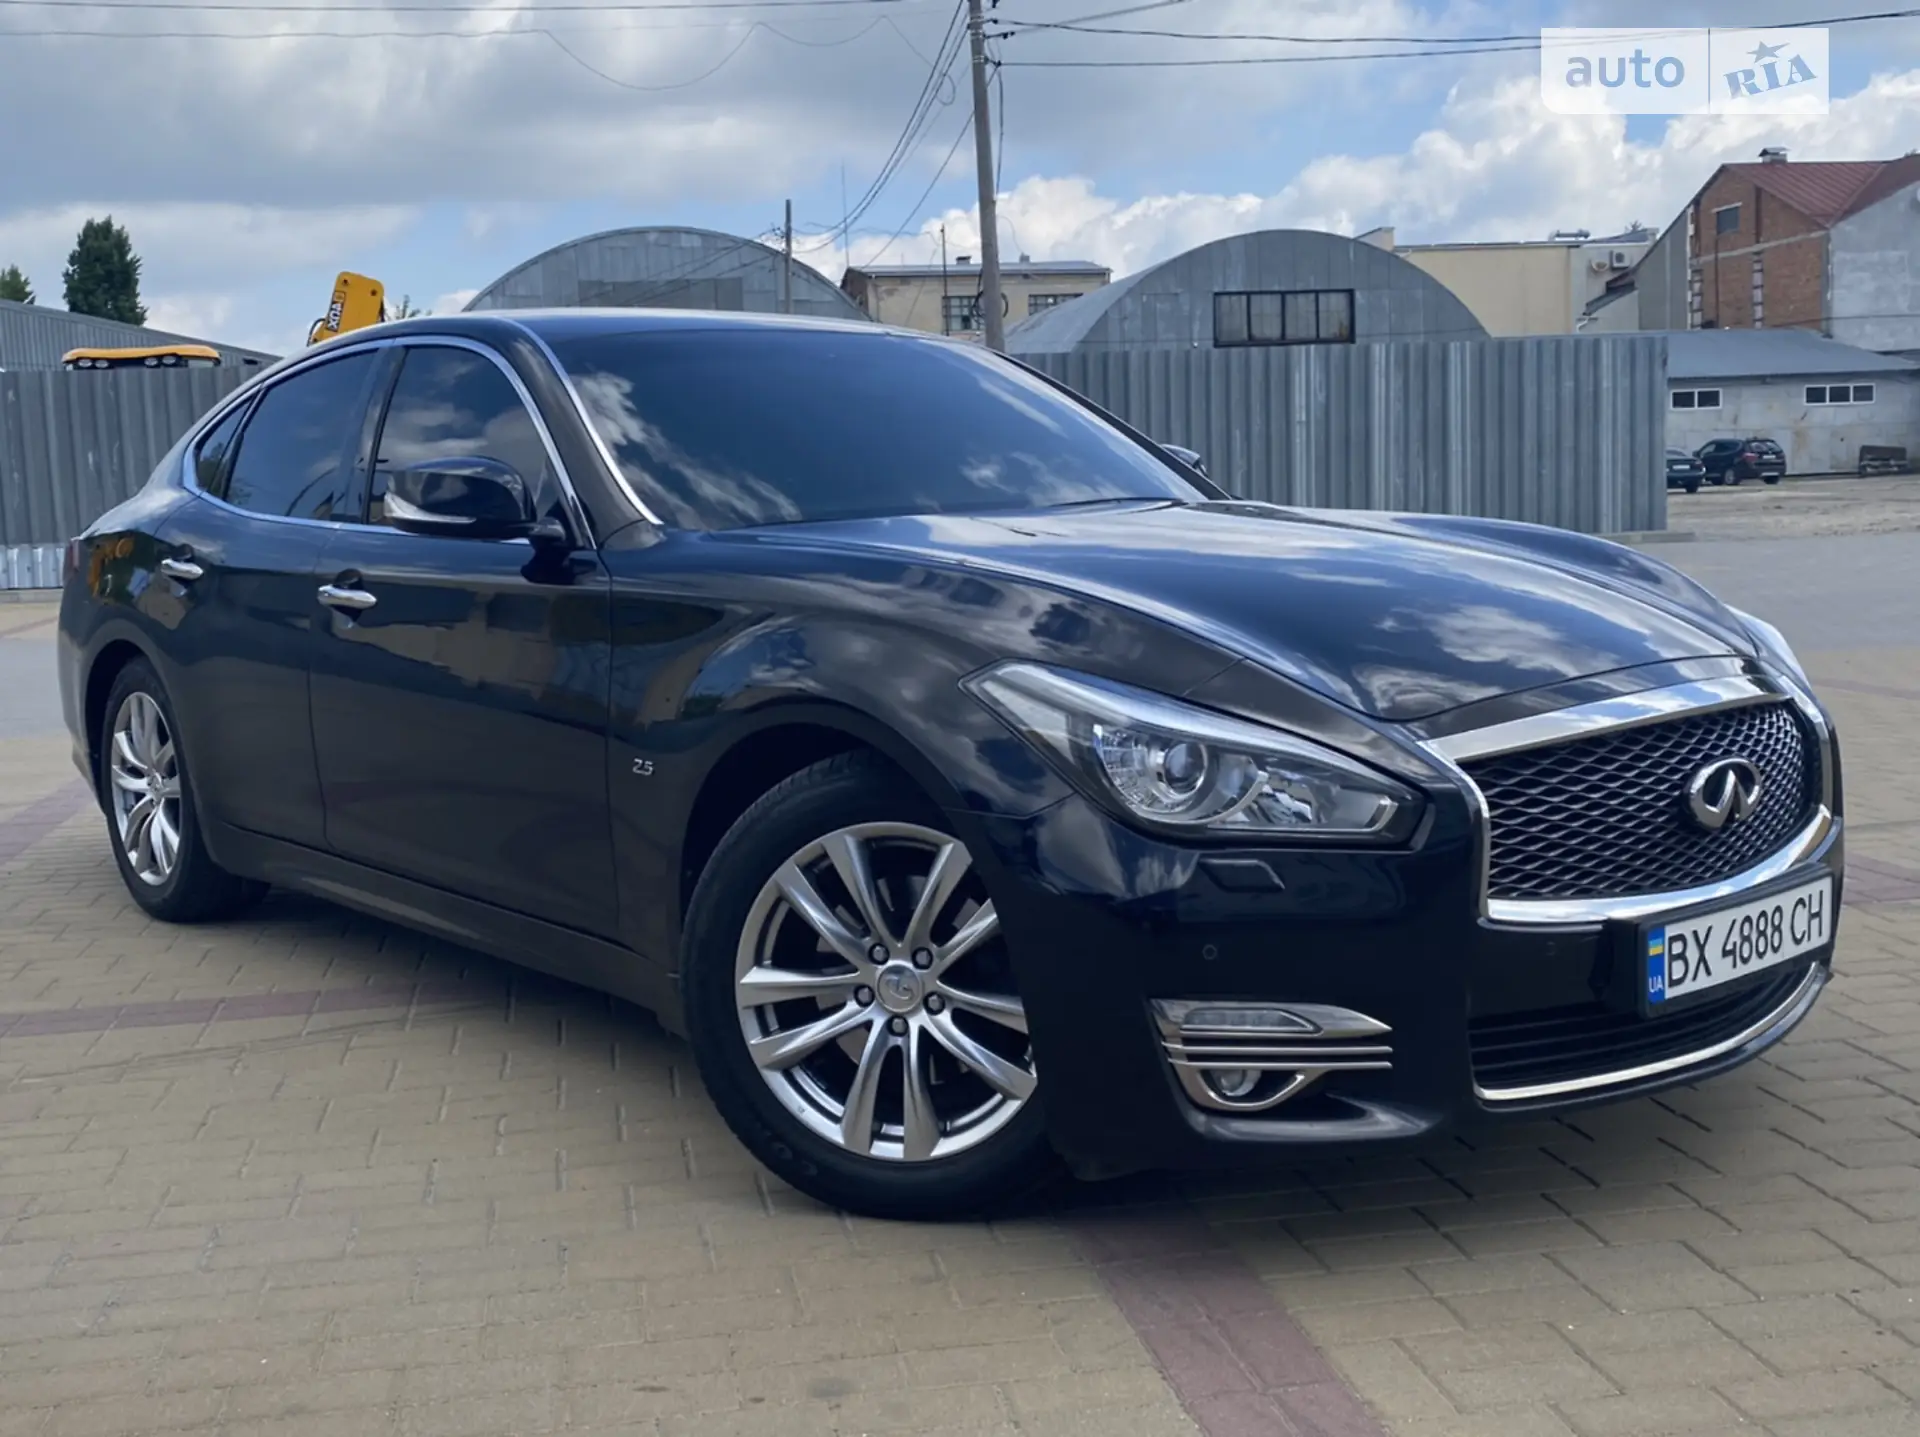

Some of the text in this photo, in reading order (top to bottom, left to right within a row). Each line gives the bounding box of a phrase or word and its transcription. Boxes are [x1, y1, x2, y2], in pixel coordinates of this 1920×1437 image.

[1667, 890, 1824, 988] BX 4888 CH
[1648, 974, 1664, 993] UA
